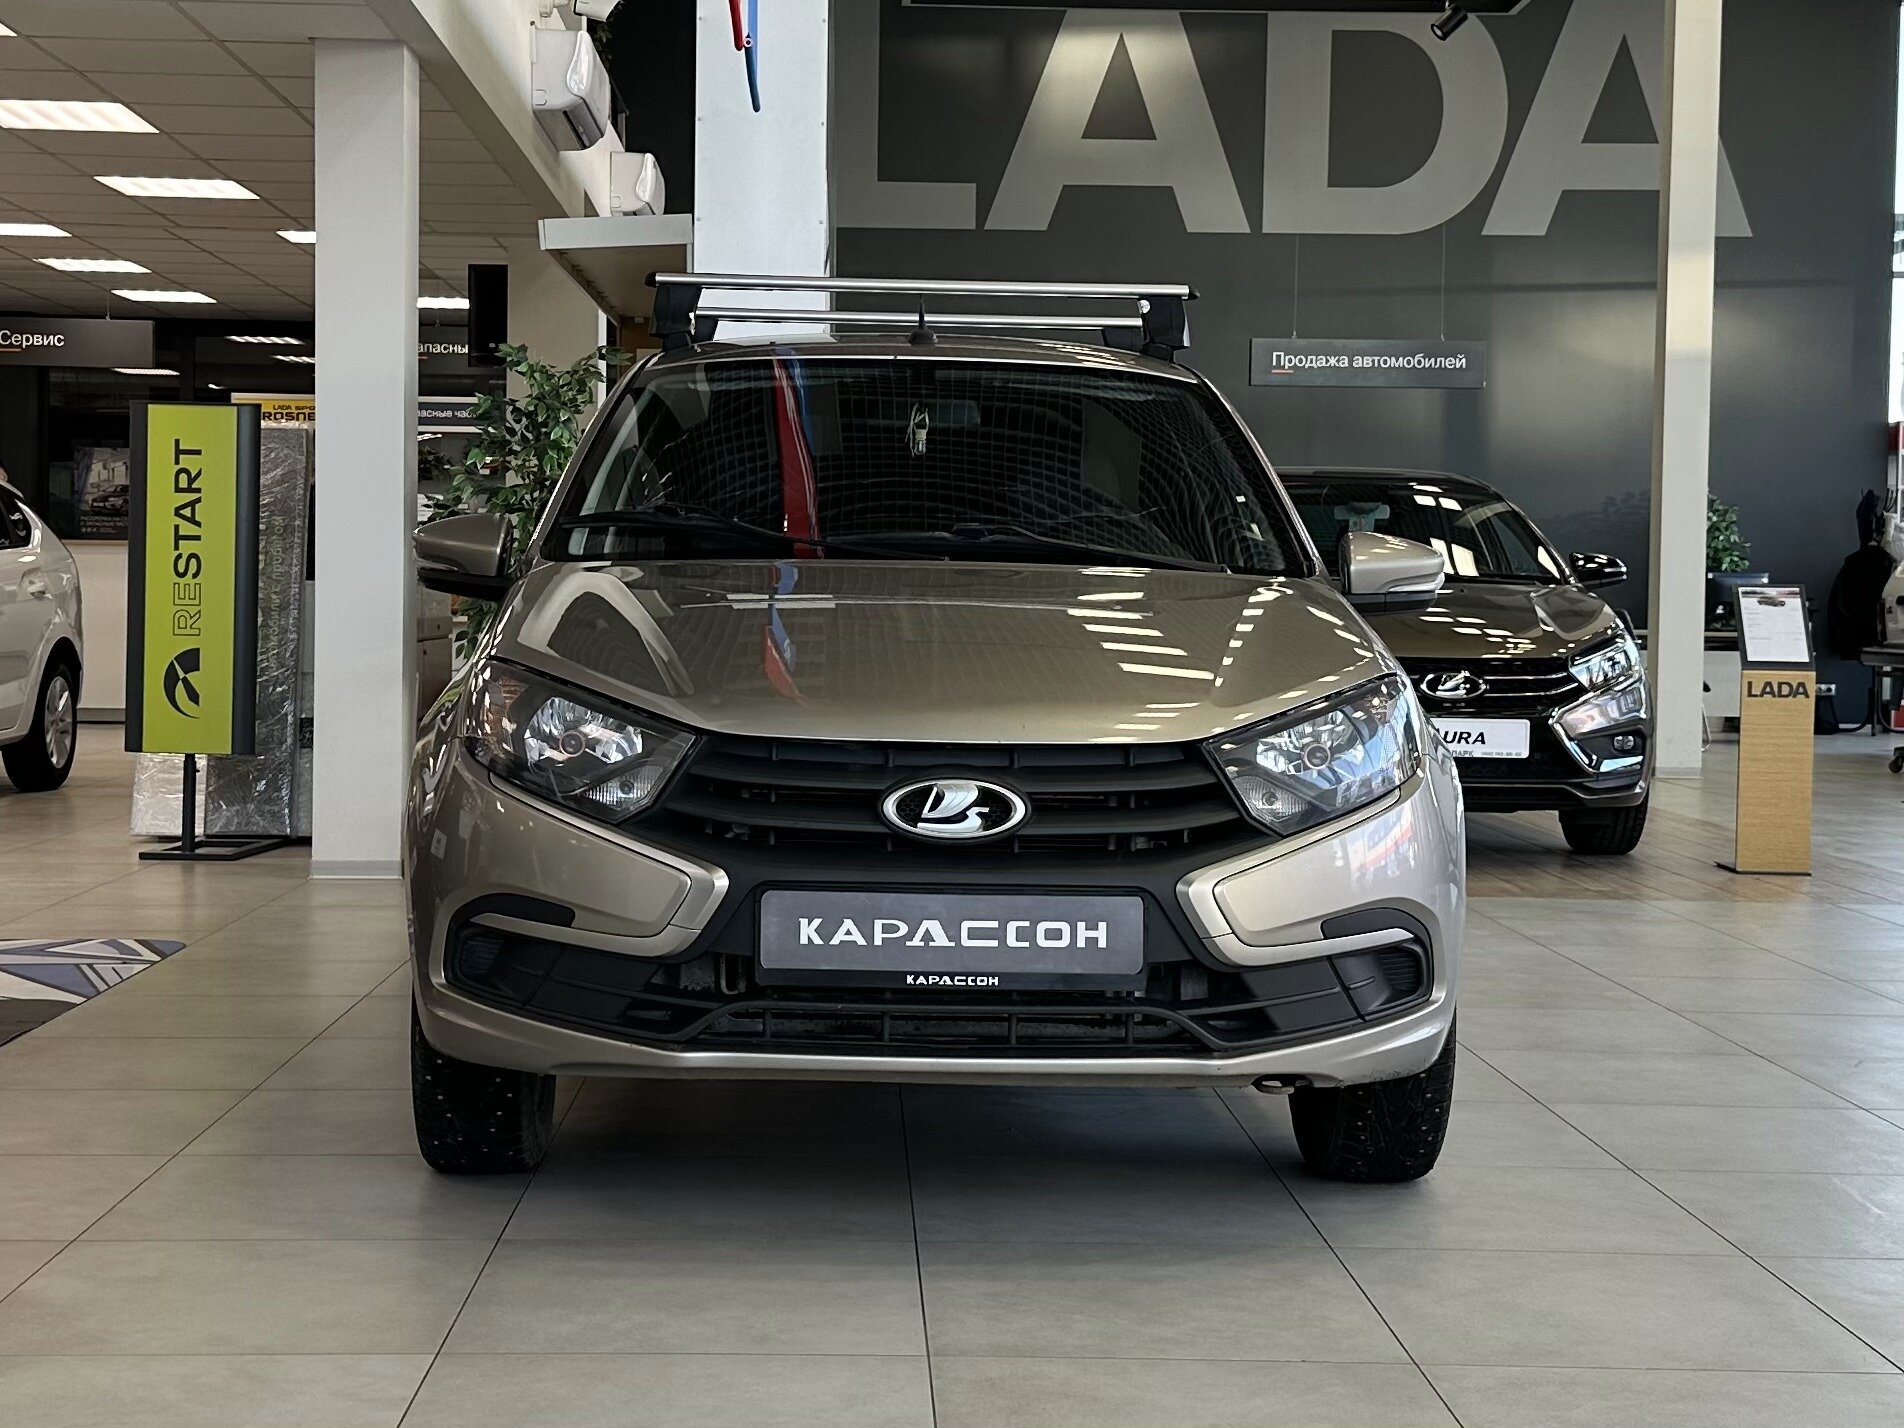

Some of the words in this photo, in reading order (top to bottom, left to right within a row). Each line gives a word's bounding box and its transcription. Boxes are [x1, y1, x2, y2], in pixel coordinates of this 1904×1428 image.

[835, 0, 1753, 237] LADA
[0, 330, 65, 348] Сервис
[1272, 351, 1348, 369] Продажа
[1352, 354, 1466, 369] автомобилей
[454, 409, 477, 418] час
[173, 438, 202, 636] RESTART
[1747, 681, 1809, 698] LADA
[1437, 730, 1486, 745] URA
[799, 918, 1107, 948] КАРАССОН
[906, 975, 998, 986] КАРАССОН
